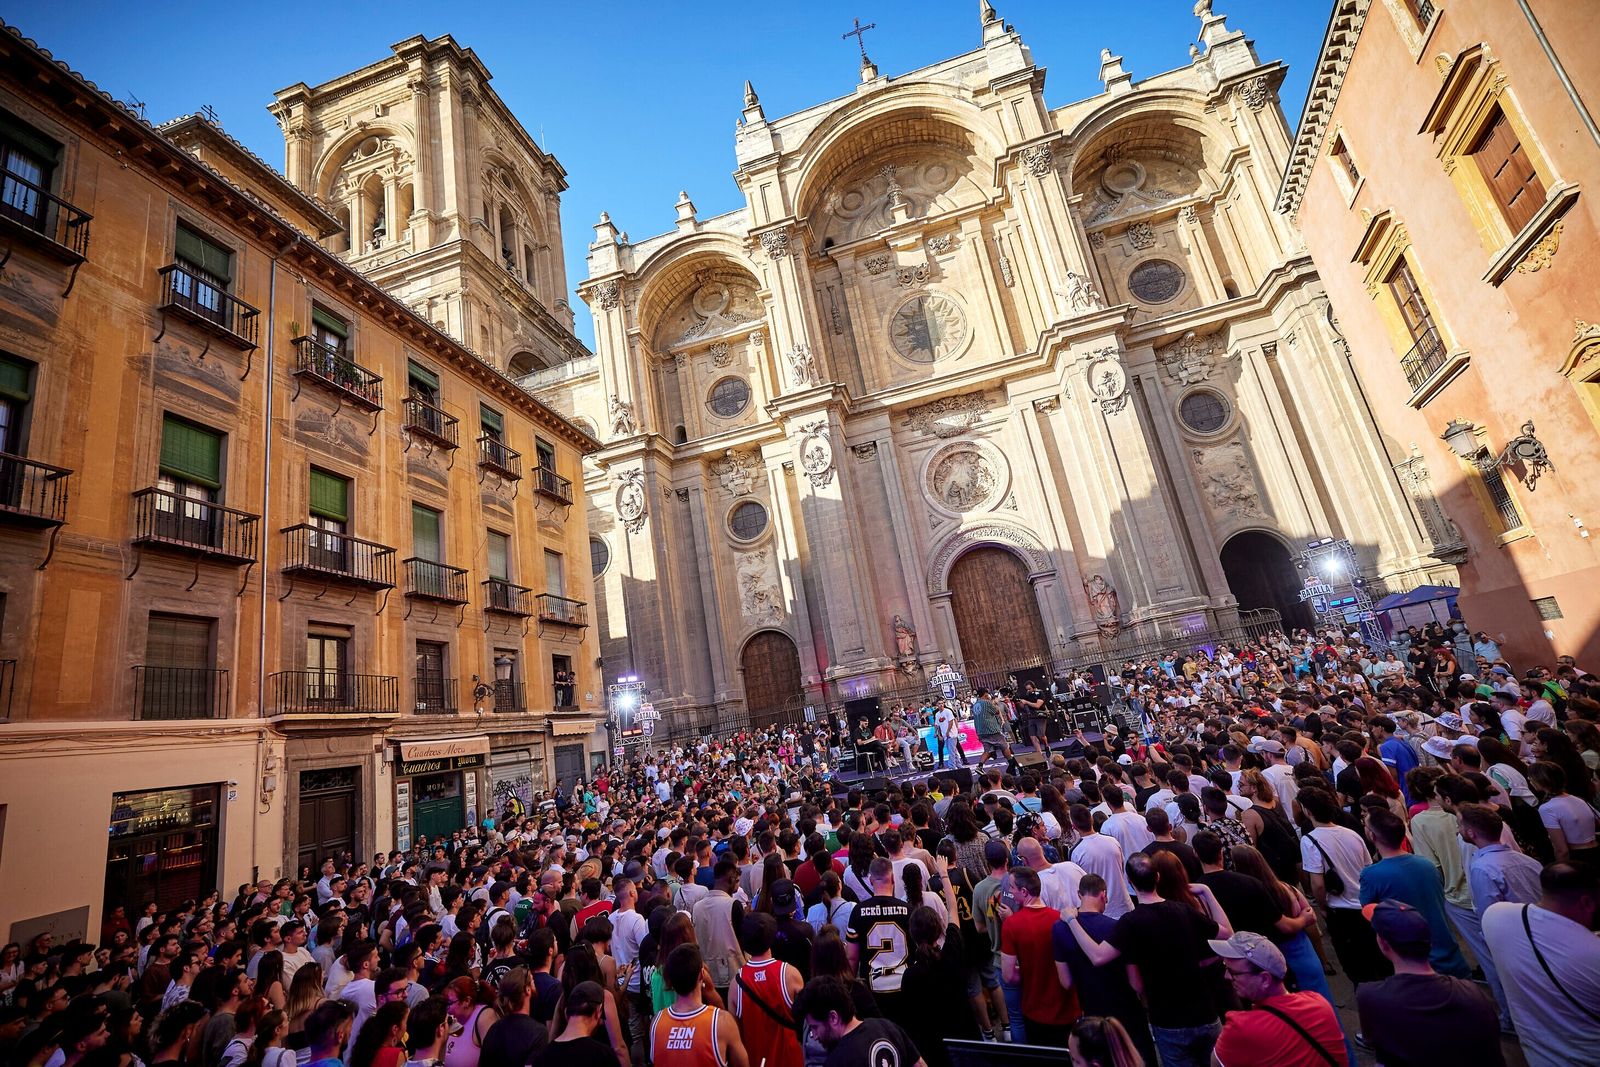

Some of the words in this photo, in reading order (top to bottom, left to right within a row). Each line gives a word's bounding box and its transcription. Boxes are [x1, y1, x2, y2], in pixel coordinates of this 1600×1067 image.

[1302, 585, 1331, 597] BATALLA
[933, 673, 959, 684] BATALLA
[408, 746, 441, 758] Cuadros
[444, 743, 466, 754] Mora
[402, 761, 440, 775] Cuadros
[138, 811, 190, 823] JOSEFINA
[882, 906, 908, 916] UNLTD
[669, 1026, 696, 1039] SON
[667, 1039, 692, 1050] GOKU
